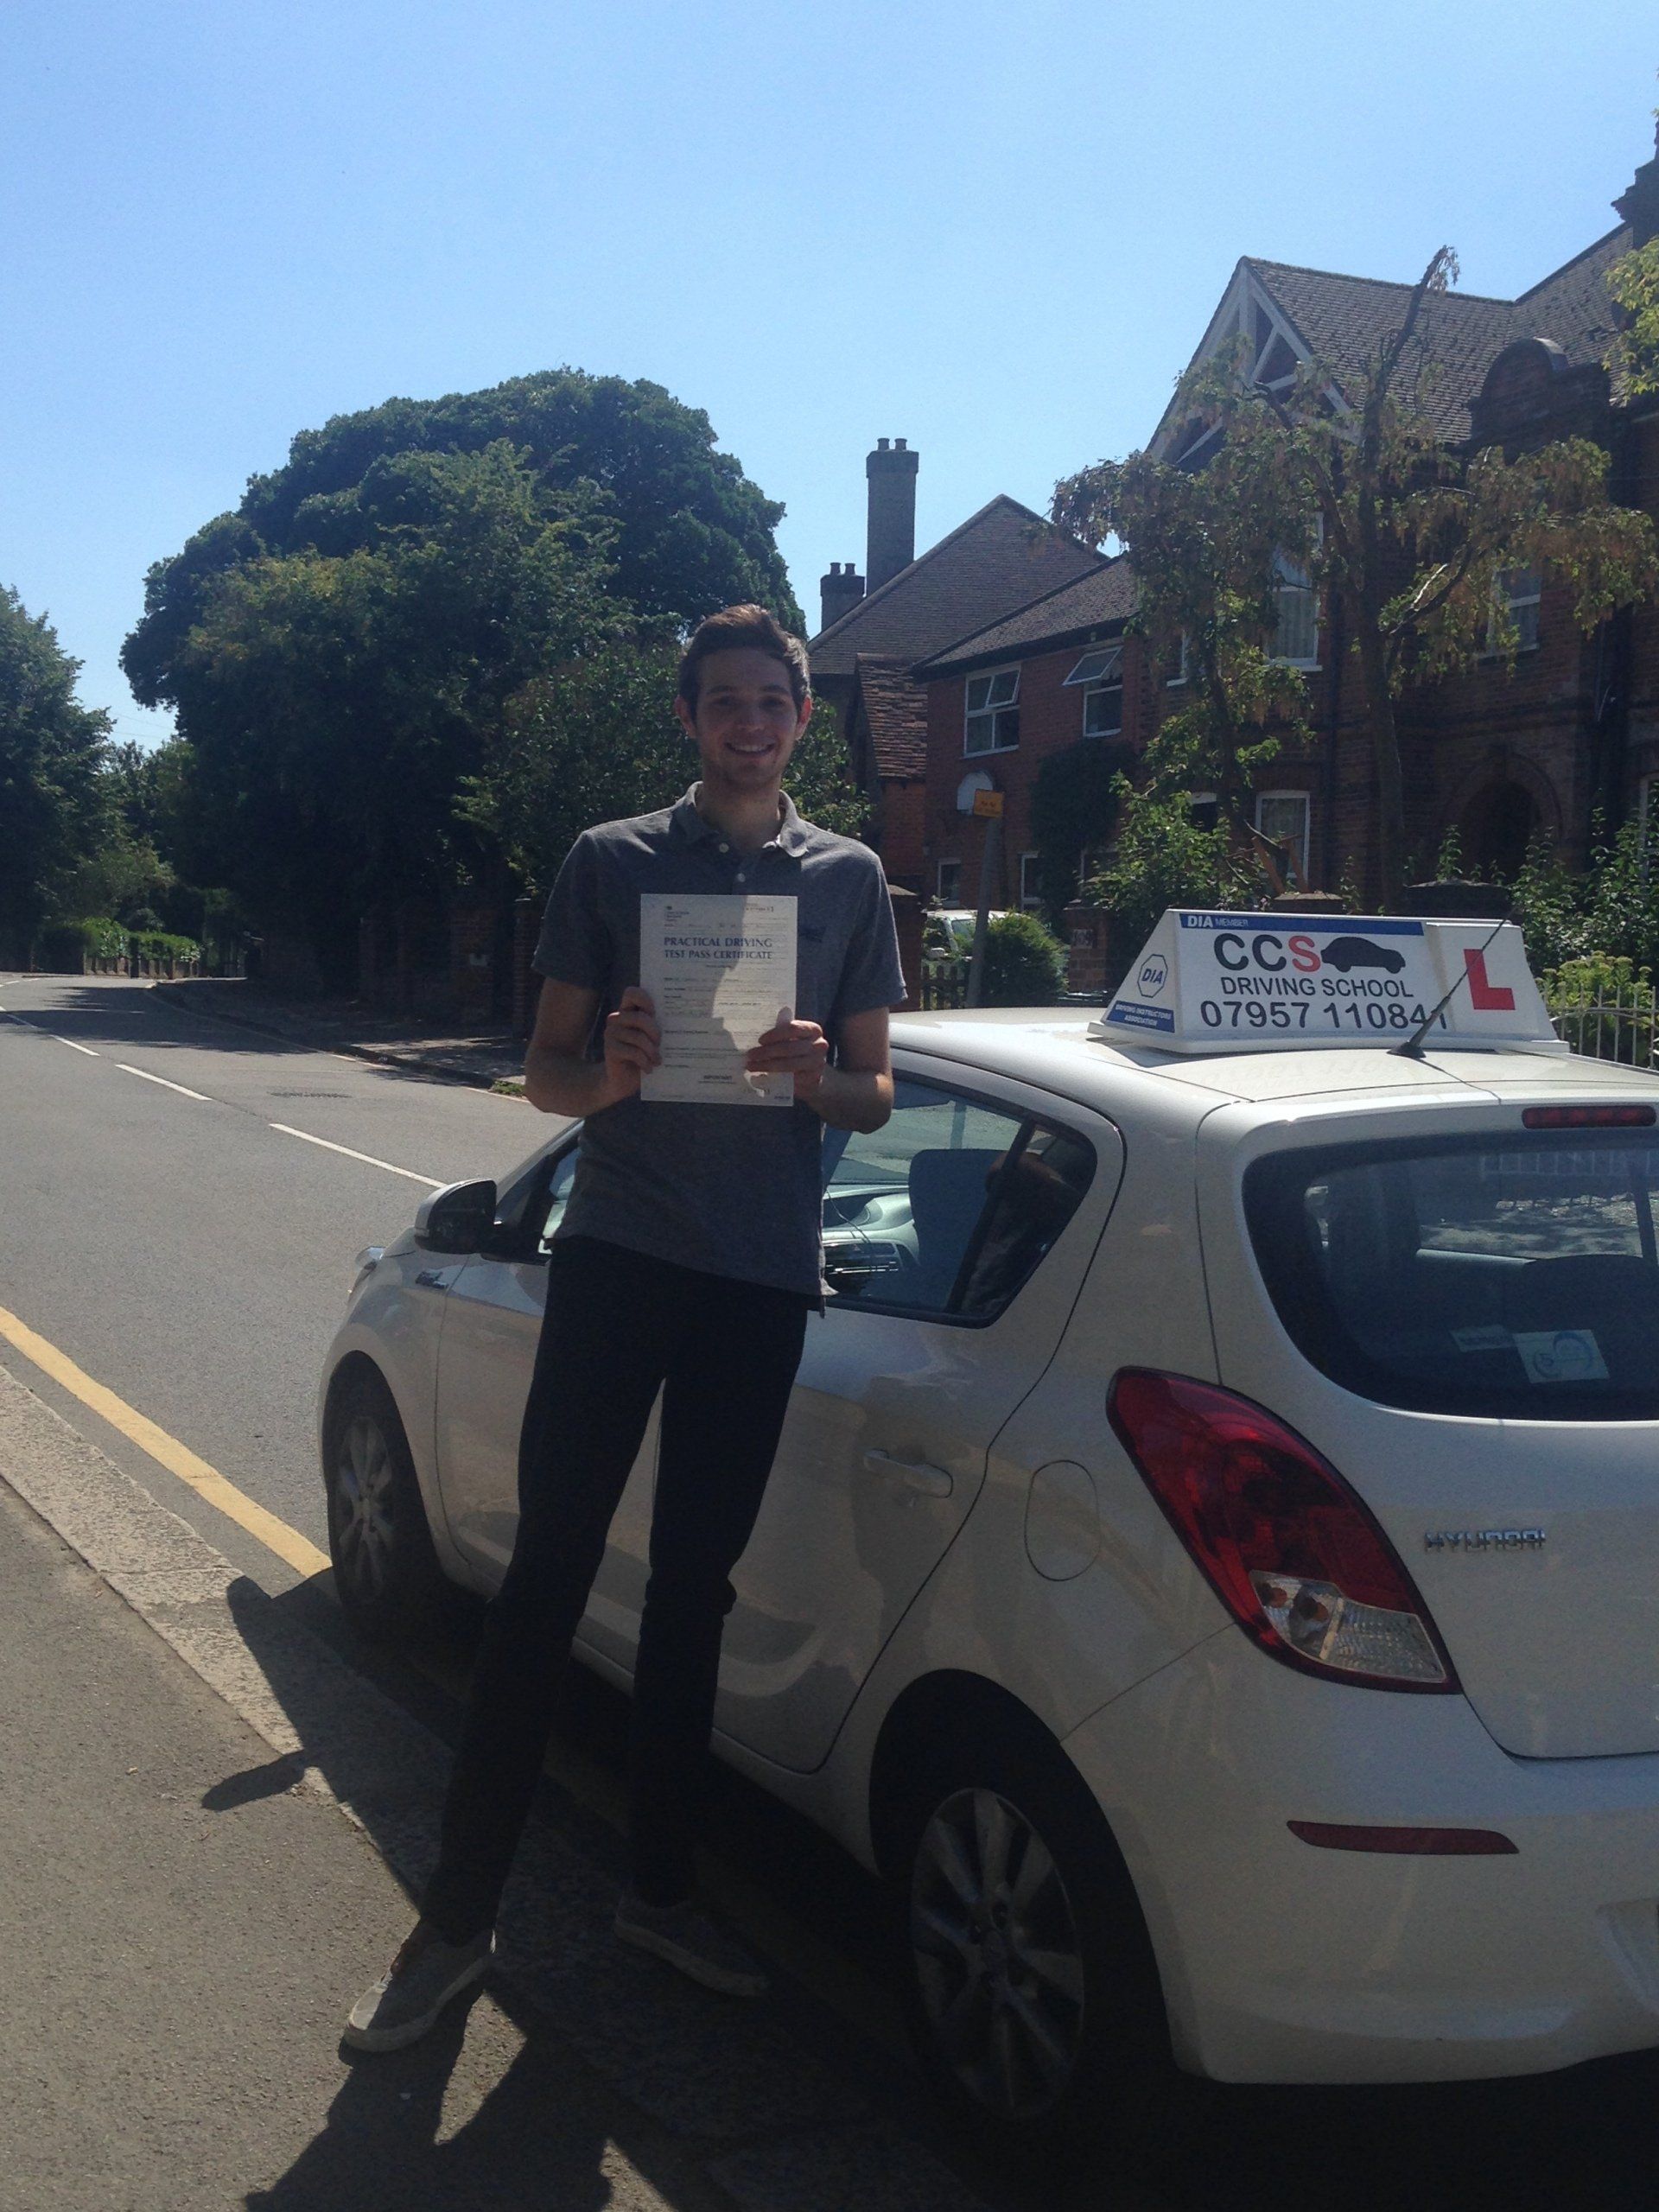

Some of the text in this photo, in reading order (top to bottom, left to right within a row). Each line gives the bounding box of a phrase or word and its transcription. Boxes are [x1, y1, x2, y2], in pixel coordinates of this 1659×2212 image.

[1187, 915, 1249, 928] DIA MEMBER
[664, 937, 773, 948] PRACTICAL DRIVING
[1214, 932, 1322, 973] CCS
[664, 950, 773, 960] TEST PASS CERTIFICATE
[1141, 968, 1164, 984] DIA
[1220, 976, 1414, 998] DRIVING SCHOOL
[1463, 948, 1516, 1011] L
[1200, 1000, 1310, 1029] 07957
[1424, 1529, 1547, 1553] HYUNDAI
